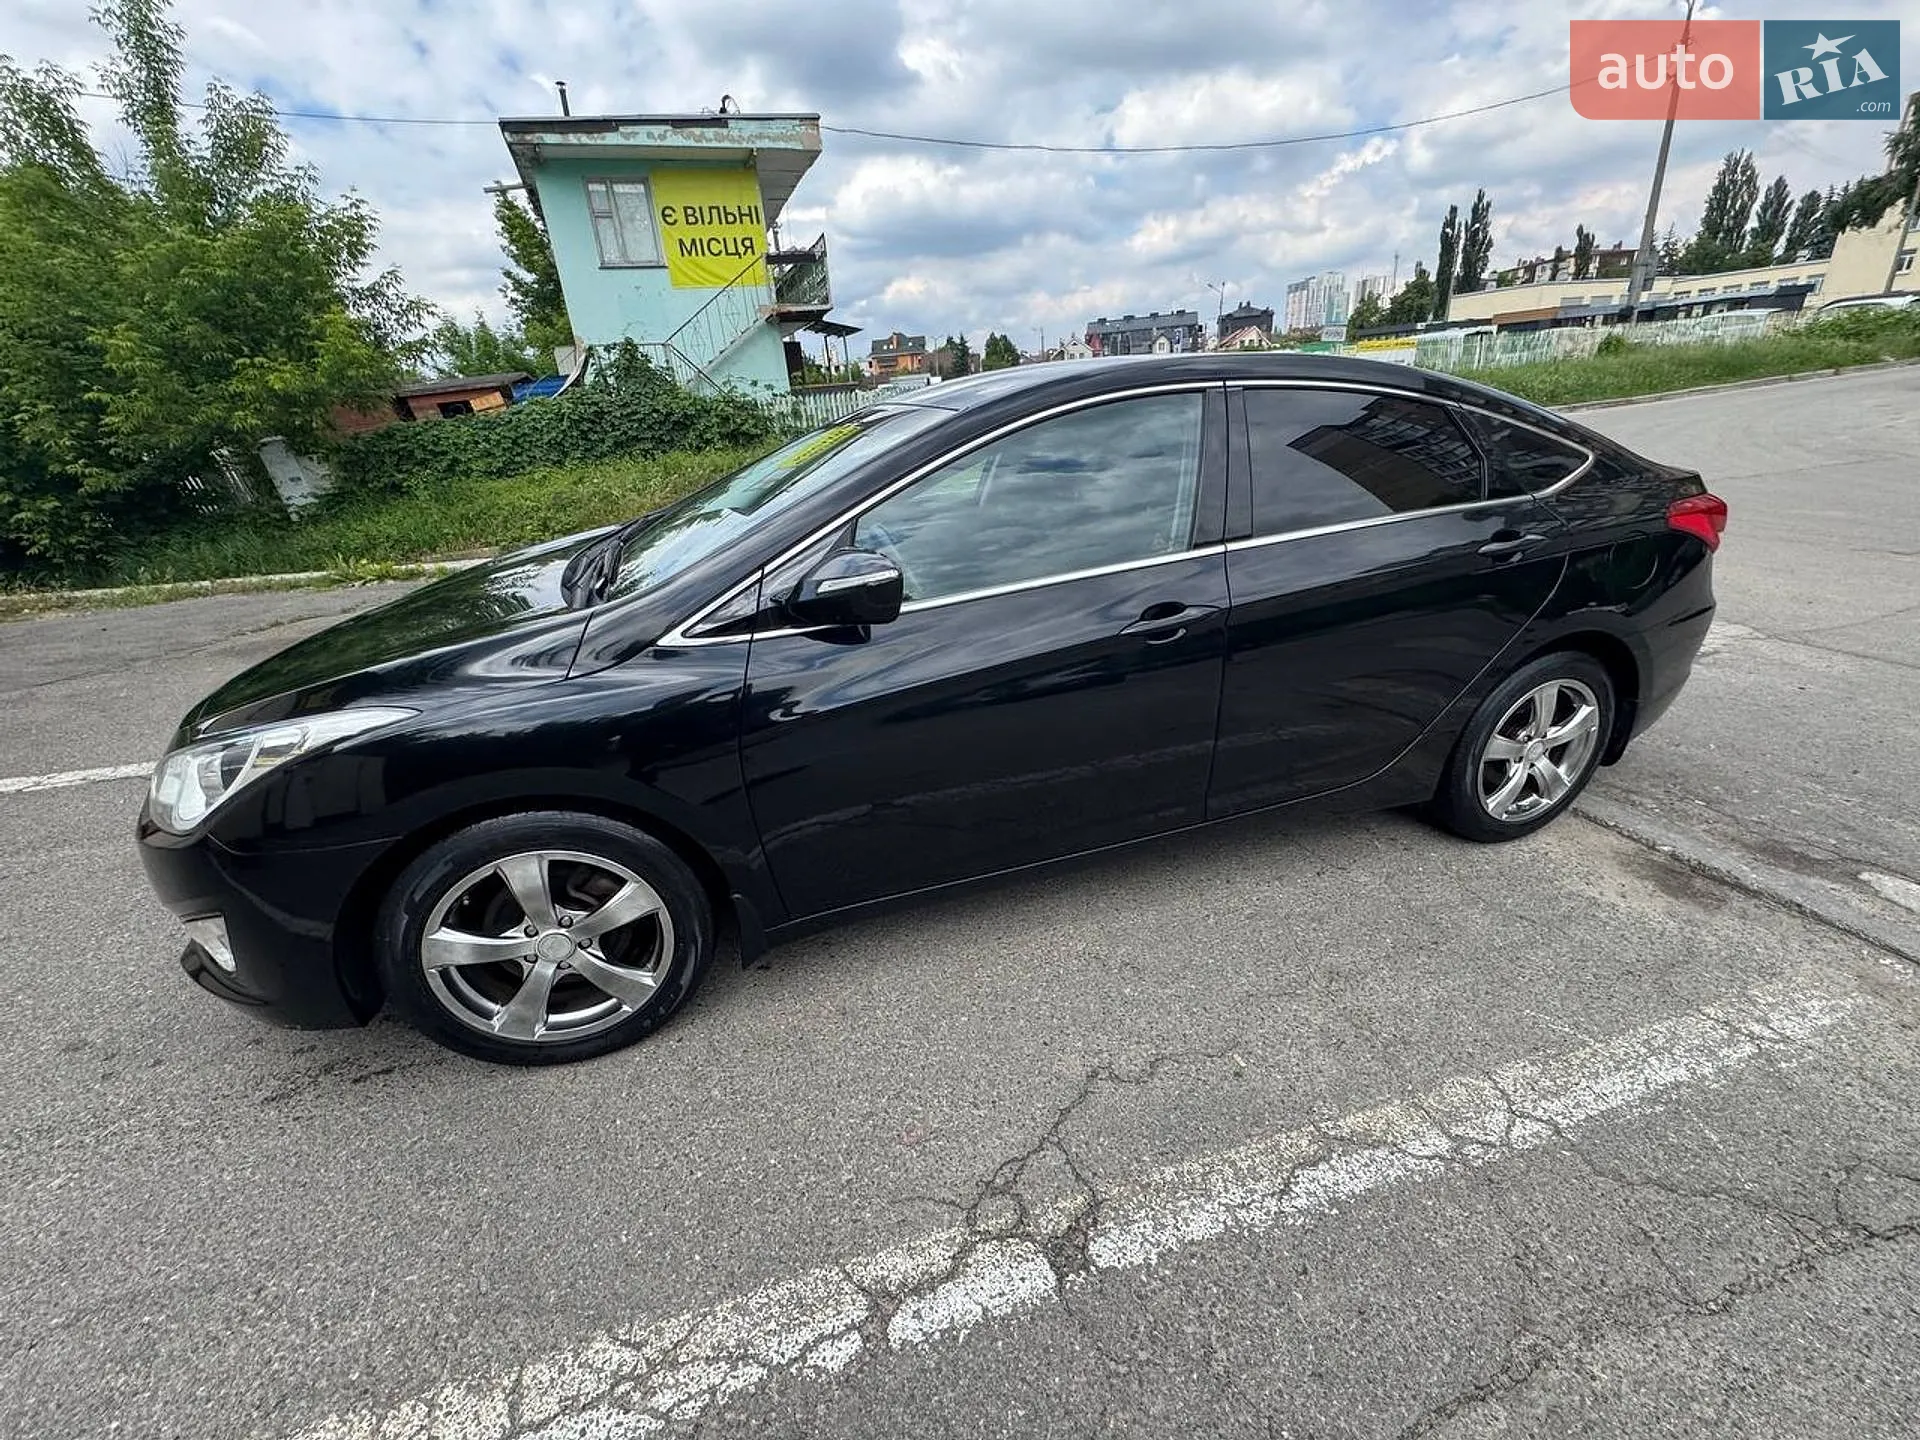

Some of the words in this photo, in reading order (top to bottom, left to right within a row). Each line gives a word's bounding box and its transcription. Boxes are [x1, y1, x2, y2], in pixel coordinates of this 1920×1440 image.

[661, 205, 678, 226] Є
[683, 205, 761, 226] ВІЛЬНІ
[678, 237, 756, 260] МІСЦЯ
